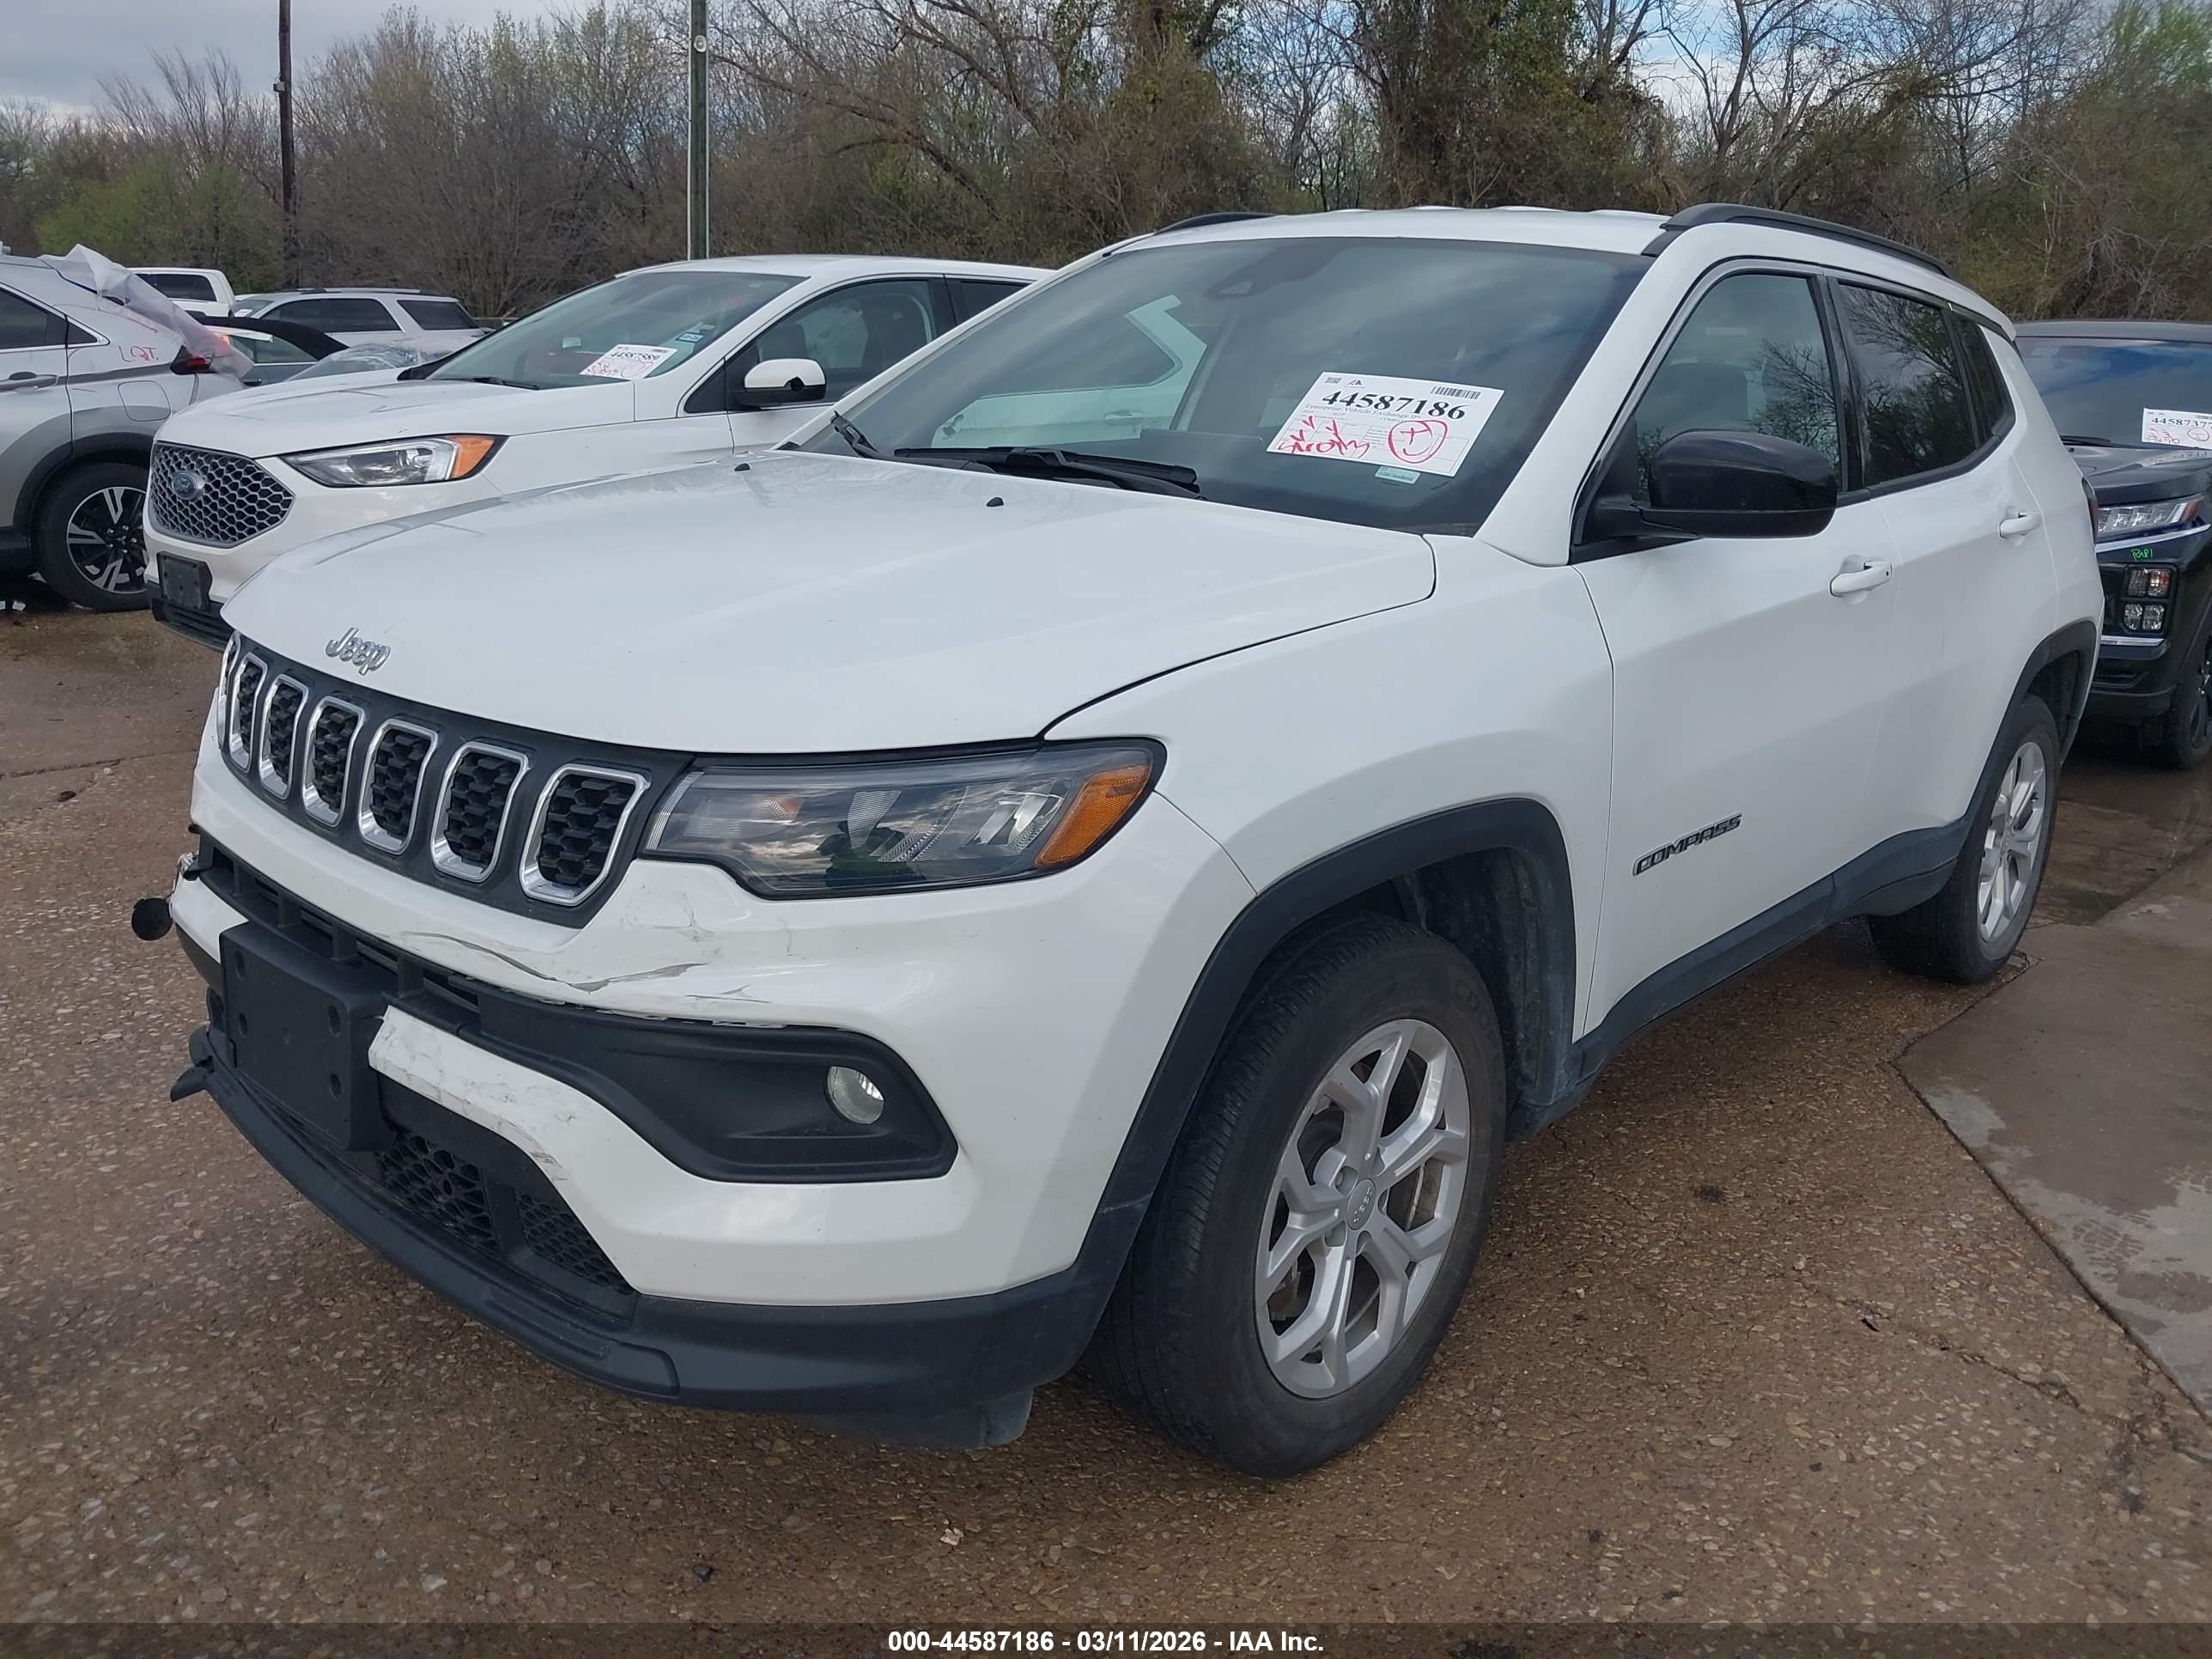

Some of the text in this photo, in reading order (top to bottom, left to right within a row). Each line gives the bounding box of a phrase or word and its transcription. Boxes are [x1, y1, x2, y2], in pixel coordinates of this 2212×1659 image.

[1322, 391, 1470, 420] 44587186
[325, 627, 392, 676] Jeep
[1632, 811, 1742, 876] COMPASS
